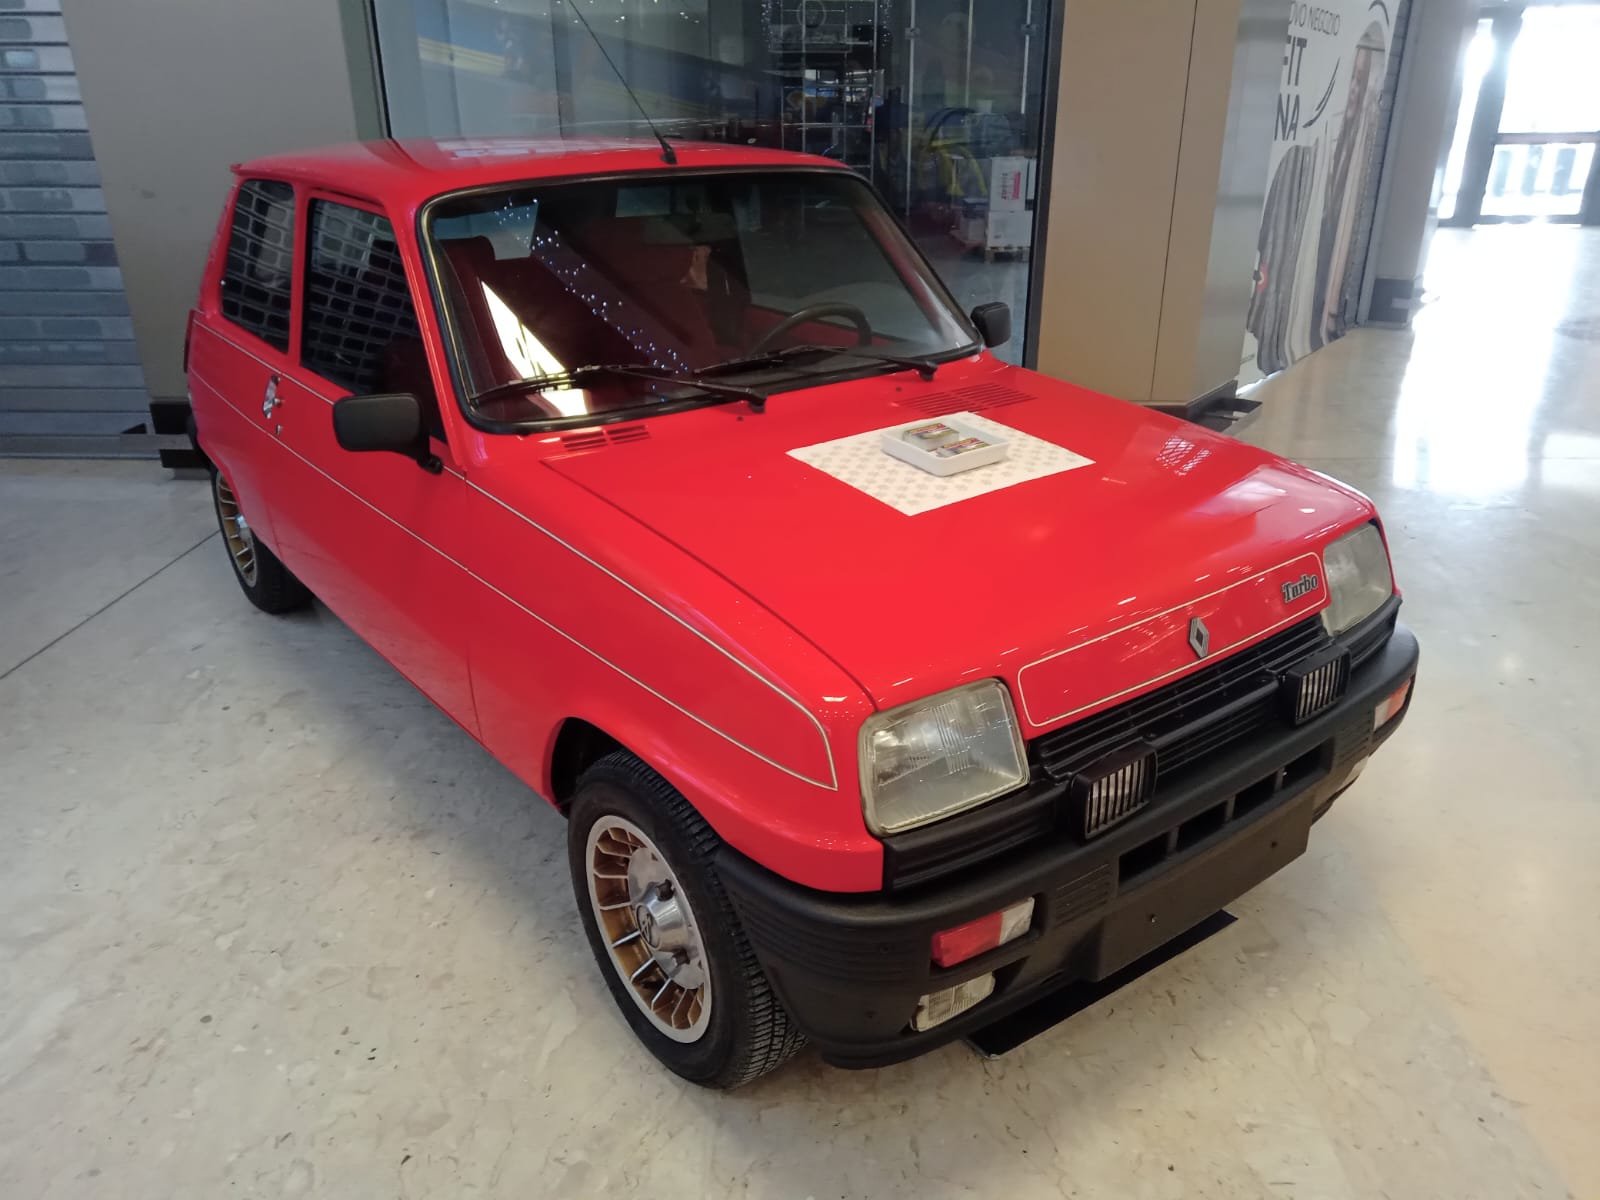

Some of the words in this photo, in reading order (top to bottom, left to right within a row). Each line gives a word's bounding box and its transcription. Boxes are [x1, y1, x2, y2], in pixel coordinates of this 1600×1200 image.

[1308, 6, 1341, 36] NEGOZIO
[1273, 93, 1300, 141] NA
[1282, 574, 1318, 603] Turbo
